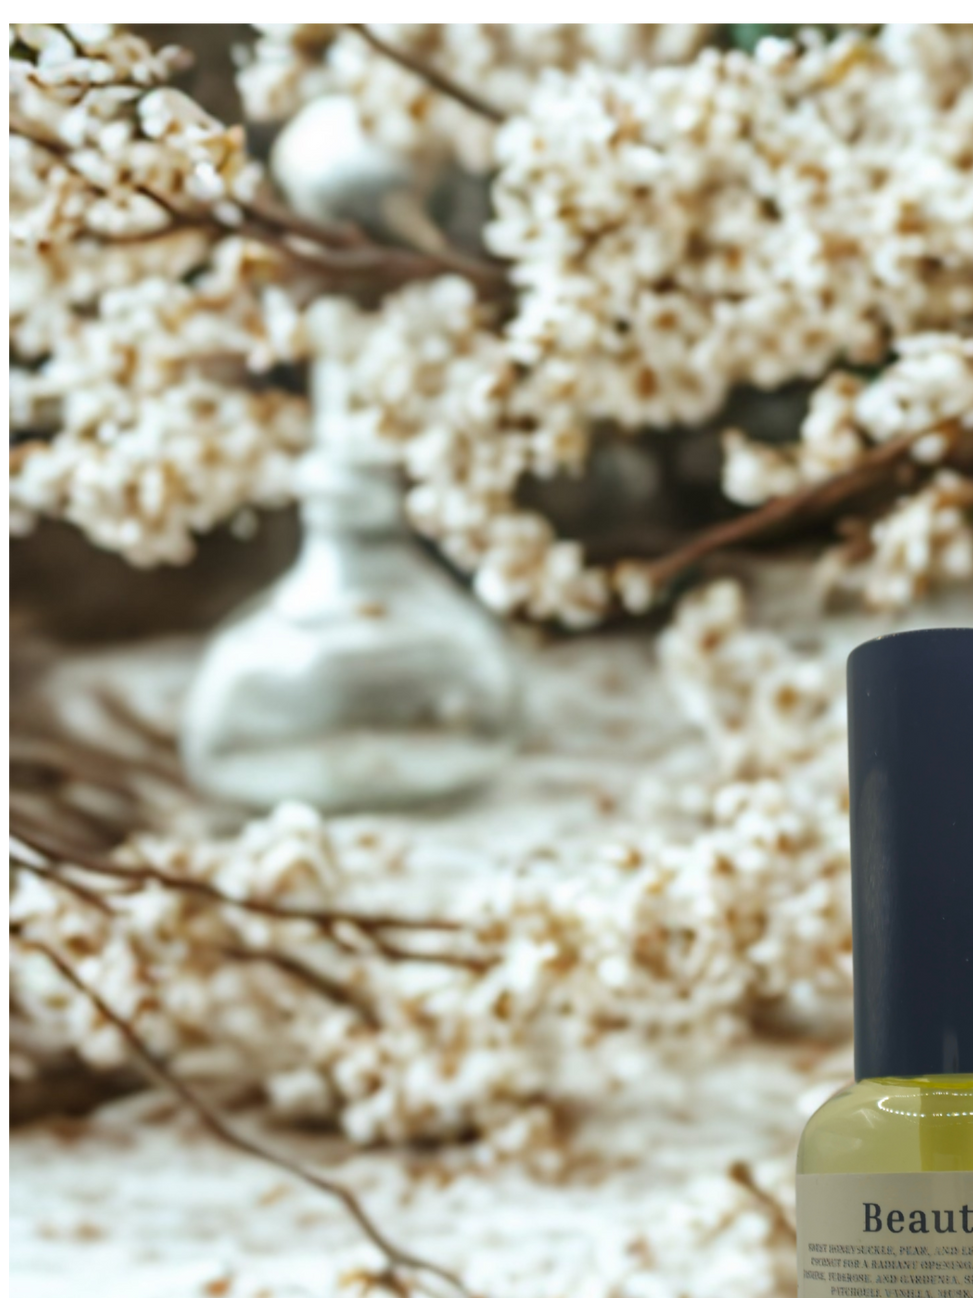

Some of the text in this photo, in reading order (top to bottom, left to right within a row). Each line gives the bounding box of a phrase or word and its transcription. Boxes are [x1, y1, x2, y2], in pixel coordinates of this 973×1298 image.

[829, 1244, 897, 1257] HONEYSUCKLE,
[899, 1246, 931, 1257] PEAR,
[934, 1246, 958, 1256] AND
[843, 1259, 860, 1269] FOR
[861, 1259, 869, 1269] A
[871, 1260, 918, 1270] RADIANT
[876, 1274, 897, 1284] AND
